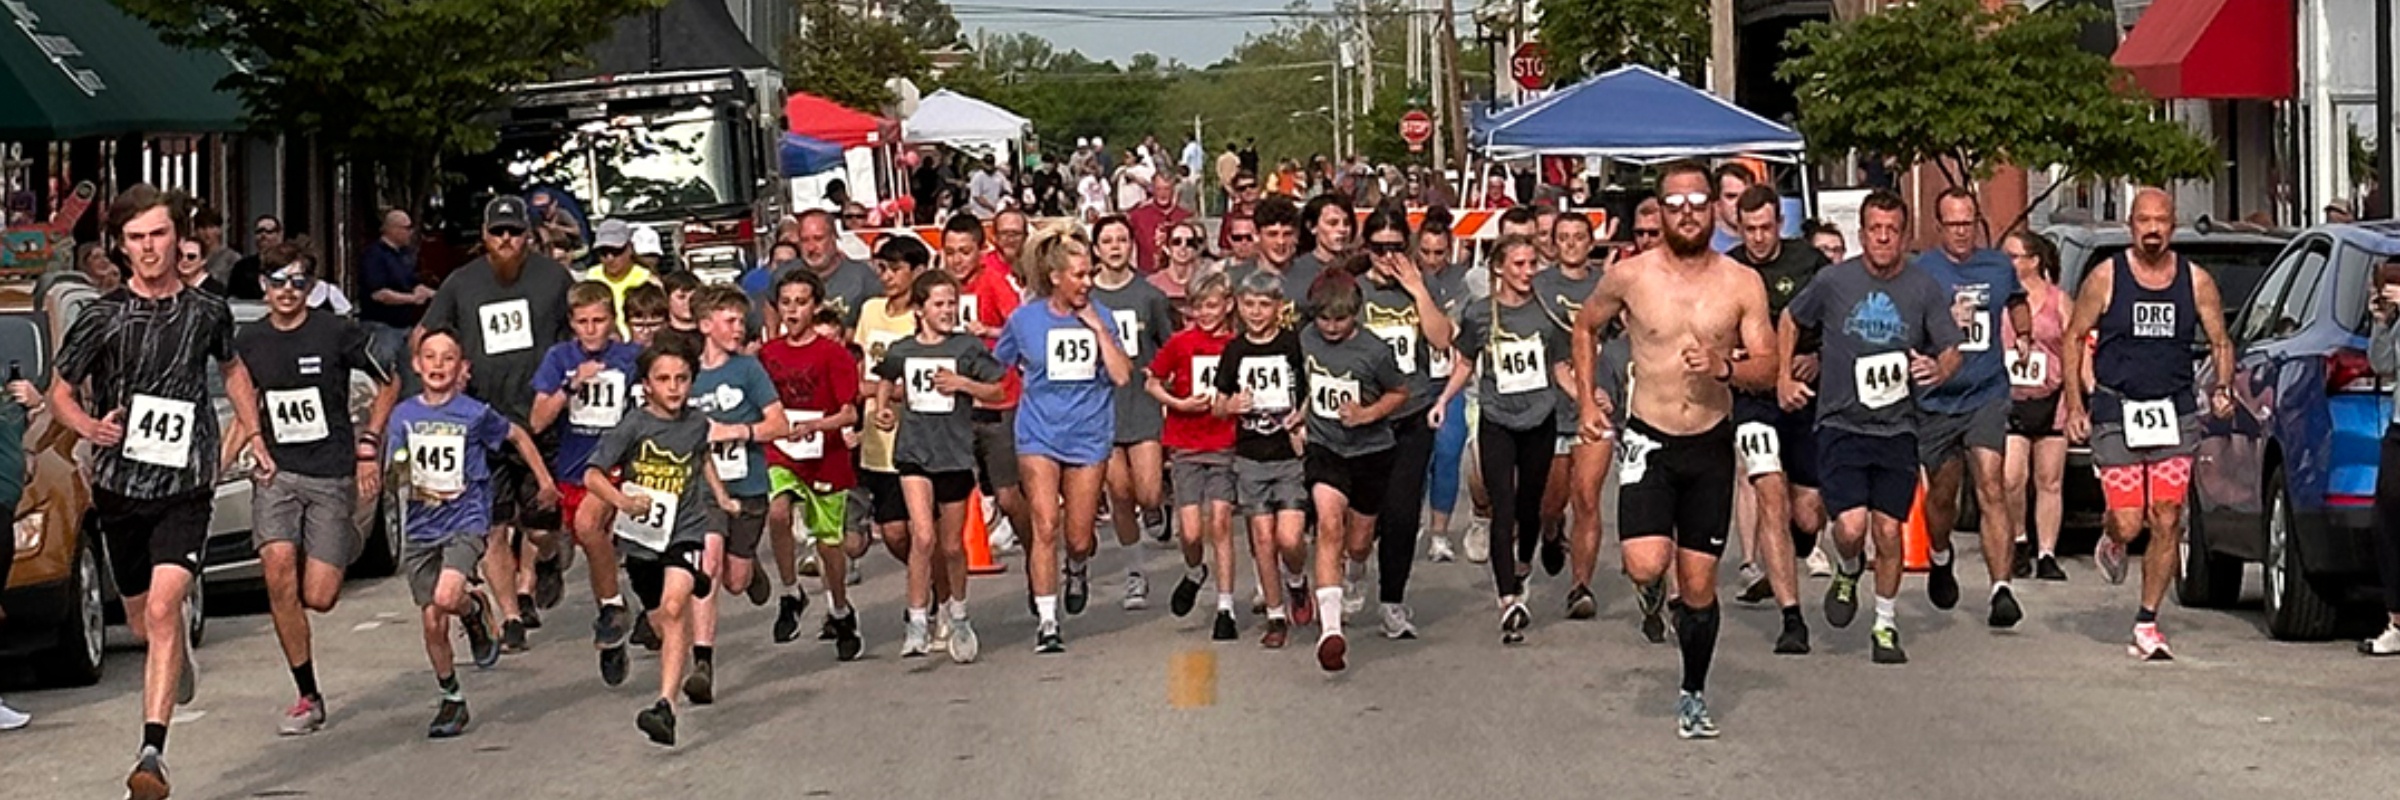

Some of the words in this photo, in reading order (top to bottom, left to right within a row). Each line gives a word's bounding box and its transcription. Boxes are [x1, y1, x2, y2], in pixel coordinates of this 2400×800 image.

[1514, 57, 1545, 77] STO
[489, 310, 523, 335] 439
[2136, 306, 2174, 323] DRC
[1055, 339, 1090, 363] 435
[1502, 350, 1538, 374] 464
[912, 369, 937, 392] 45
[1247, 366, 1281, 390] 454
[1865, 363, 1902, 389] 444
[277, 400, 316, 425] 446
[2132, 407, 2170, 429] 451
[138, 409, 186, 443] 443
[416, 445, 456, 472] 445
[712, 440, 740, 461] 42
